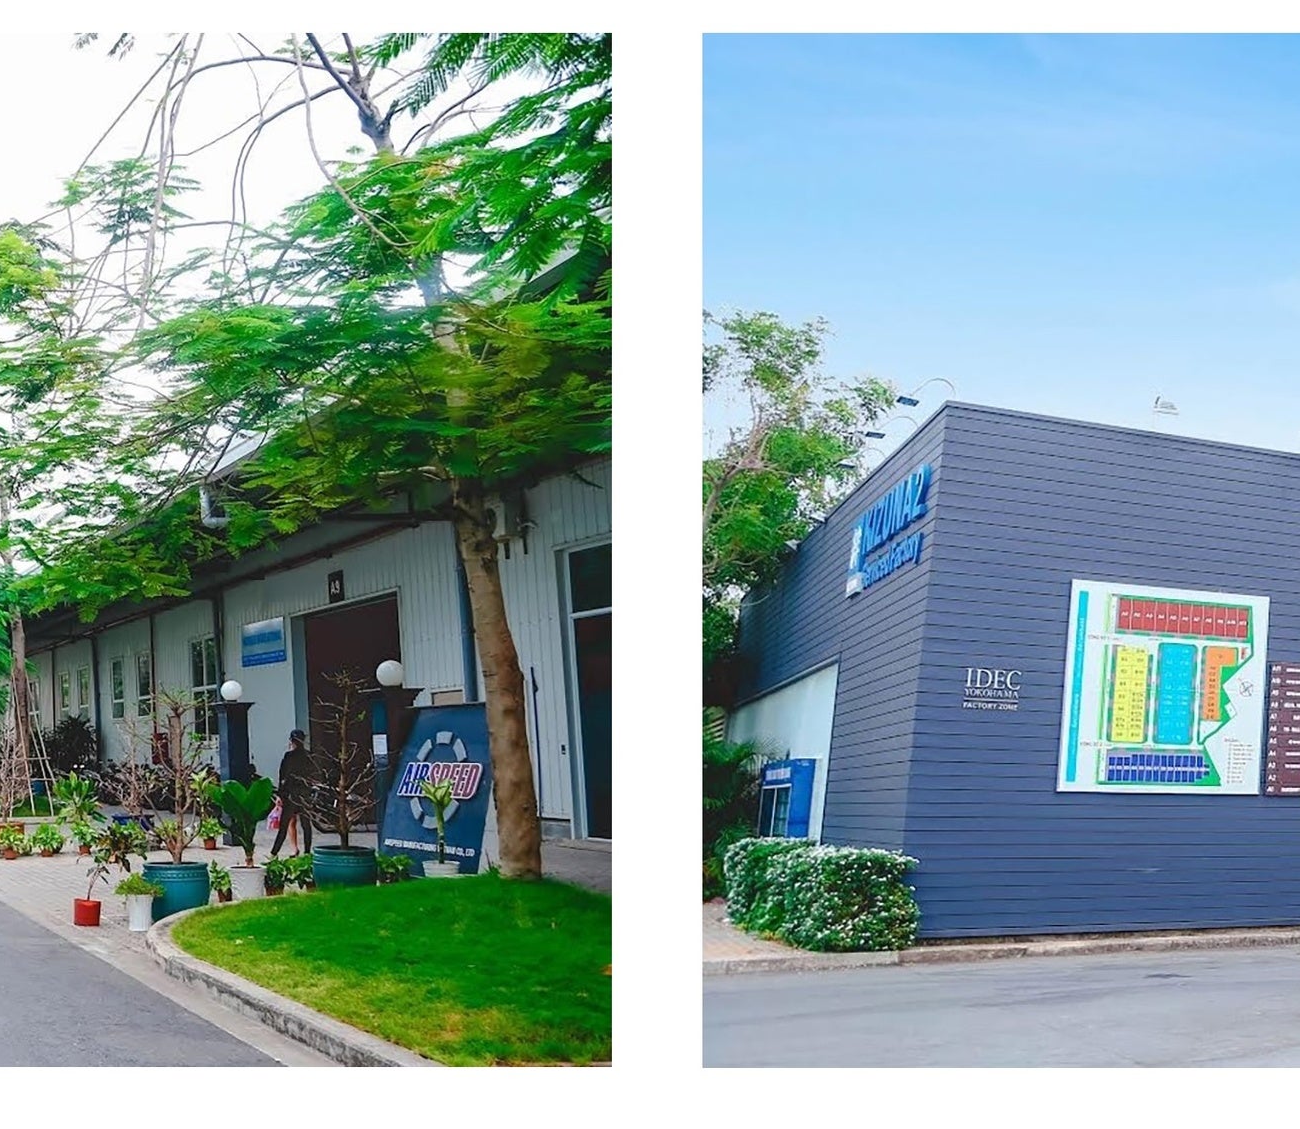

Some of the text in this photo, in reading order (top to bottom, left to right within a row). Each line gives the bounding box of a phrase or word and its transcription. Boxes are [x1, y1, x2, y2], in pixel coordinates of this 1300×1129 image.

[860, 463, 931, 555] KIZUNA2
[965, 668, 1022, 690] IDEC
[964, 688, 1019, 699] YOKOHAMA
[963, 702, 997, 710] FACTORY
[397, 762, 483, 799] AIRSPEED
